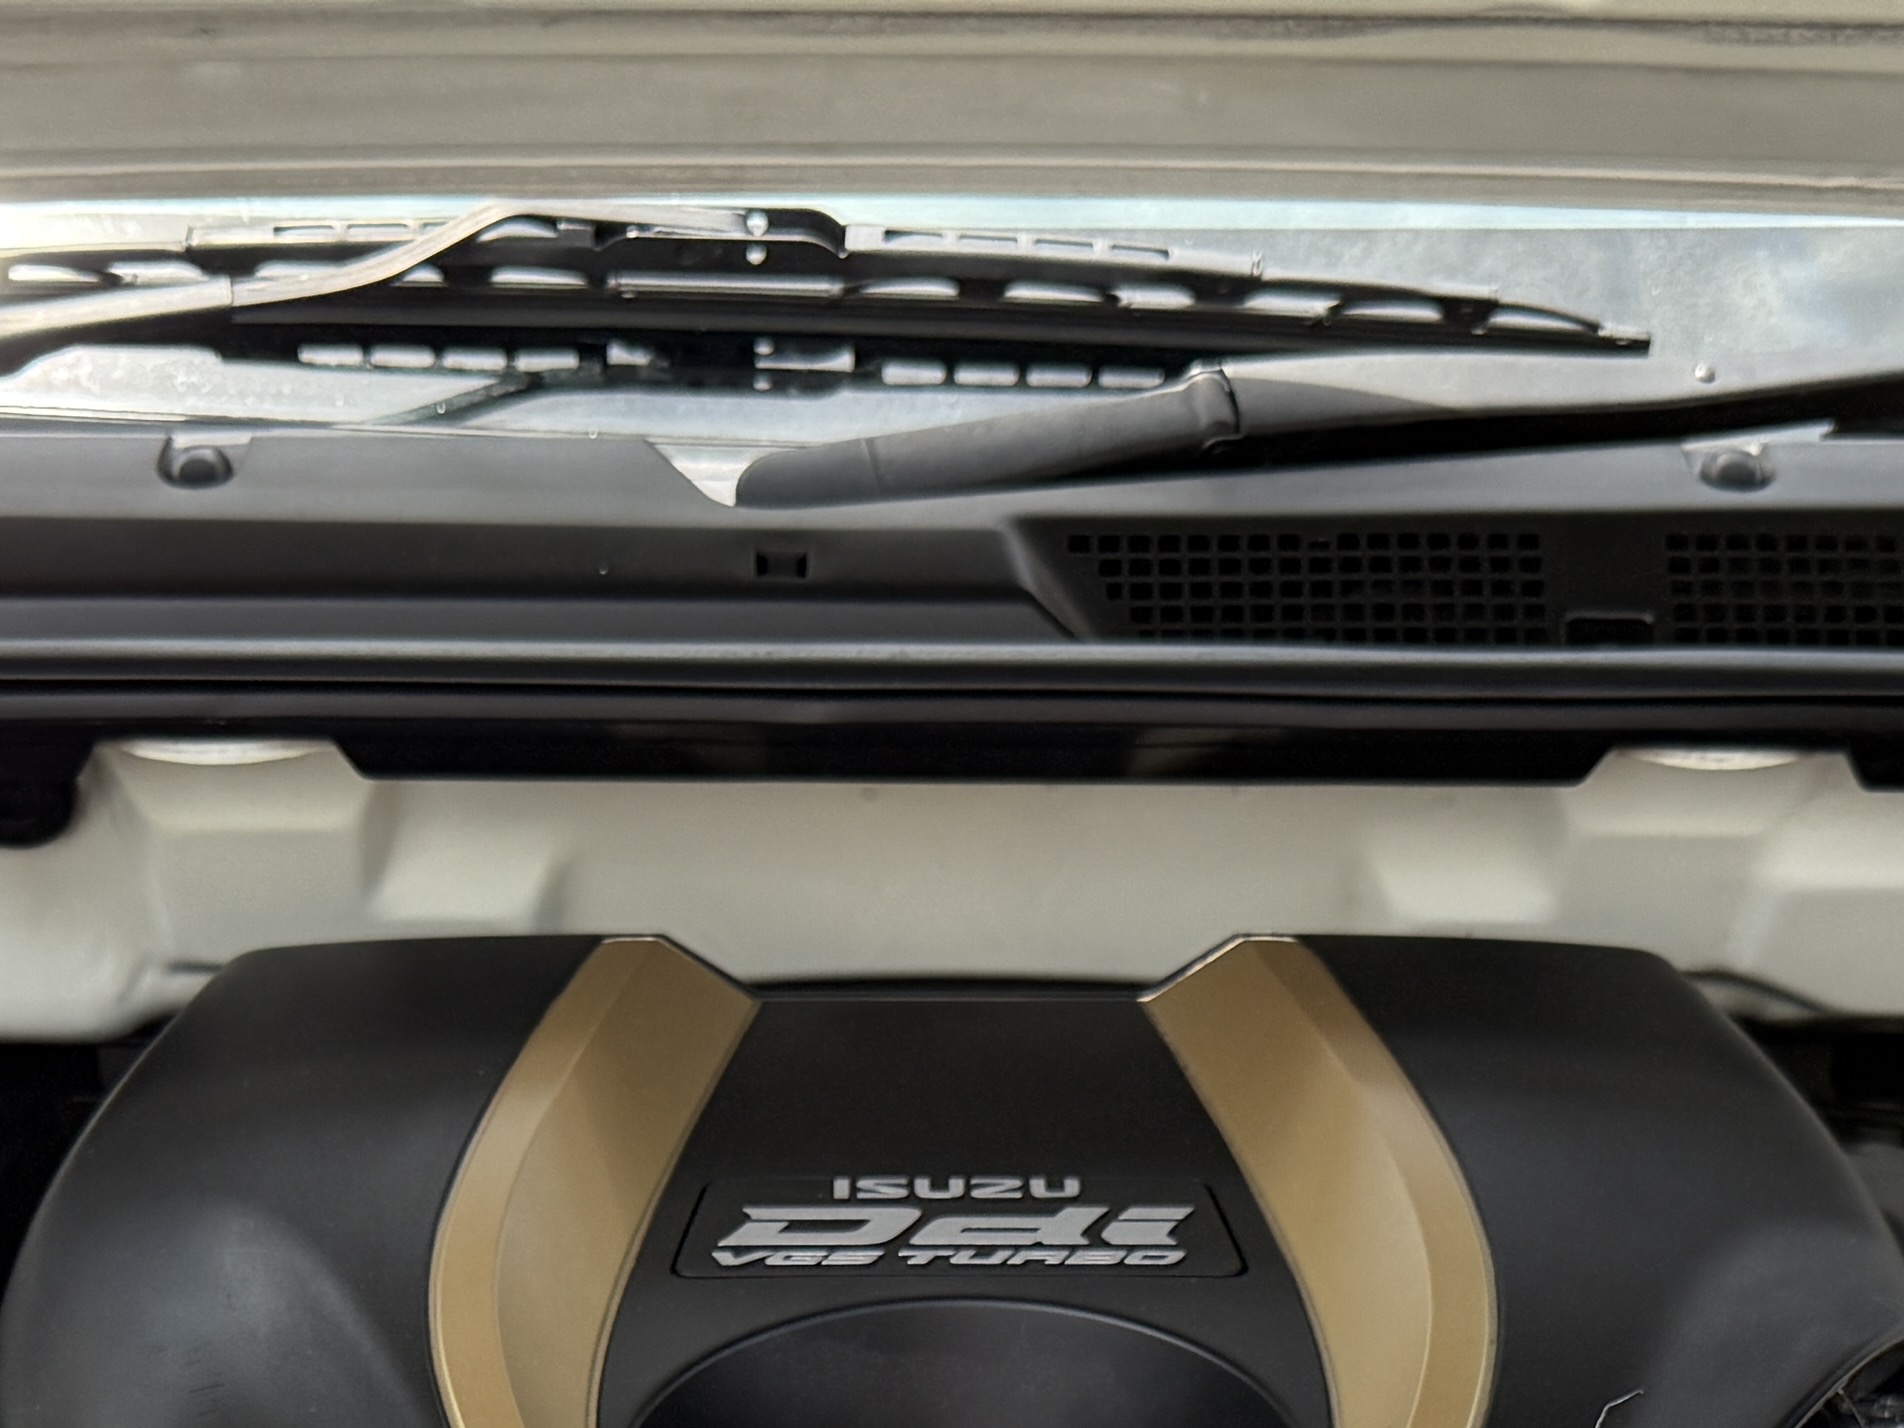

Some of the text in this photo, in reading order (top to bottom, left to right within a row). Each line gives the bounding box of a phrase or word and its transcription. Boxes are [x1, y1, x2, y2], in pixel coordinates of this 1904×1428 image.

[832, 1175, 1082, 1200] ISUZU
[710, 1247, 1189, 1267] VGS TURBO
